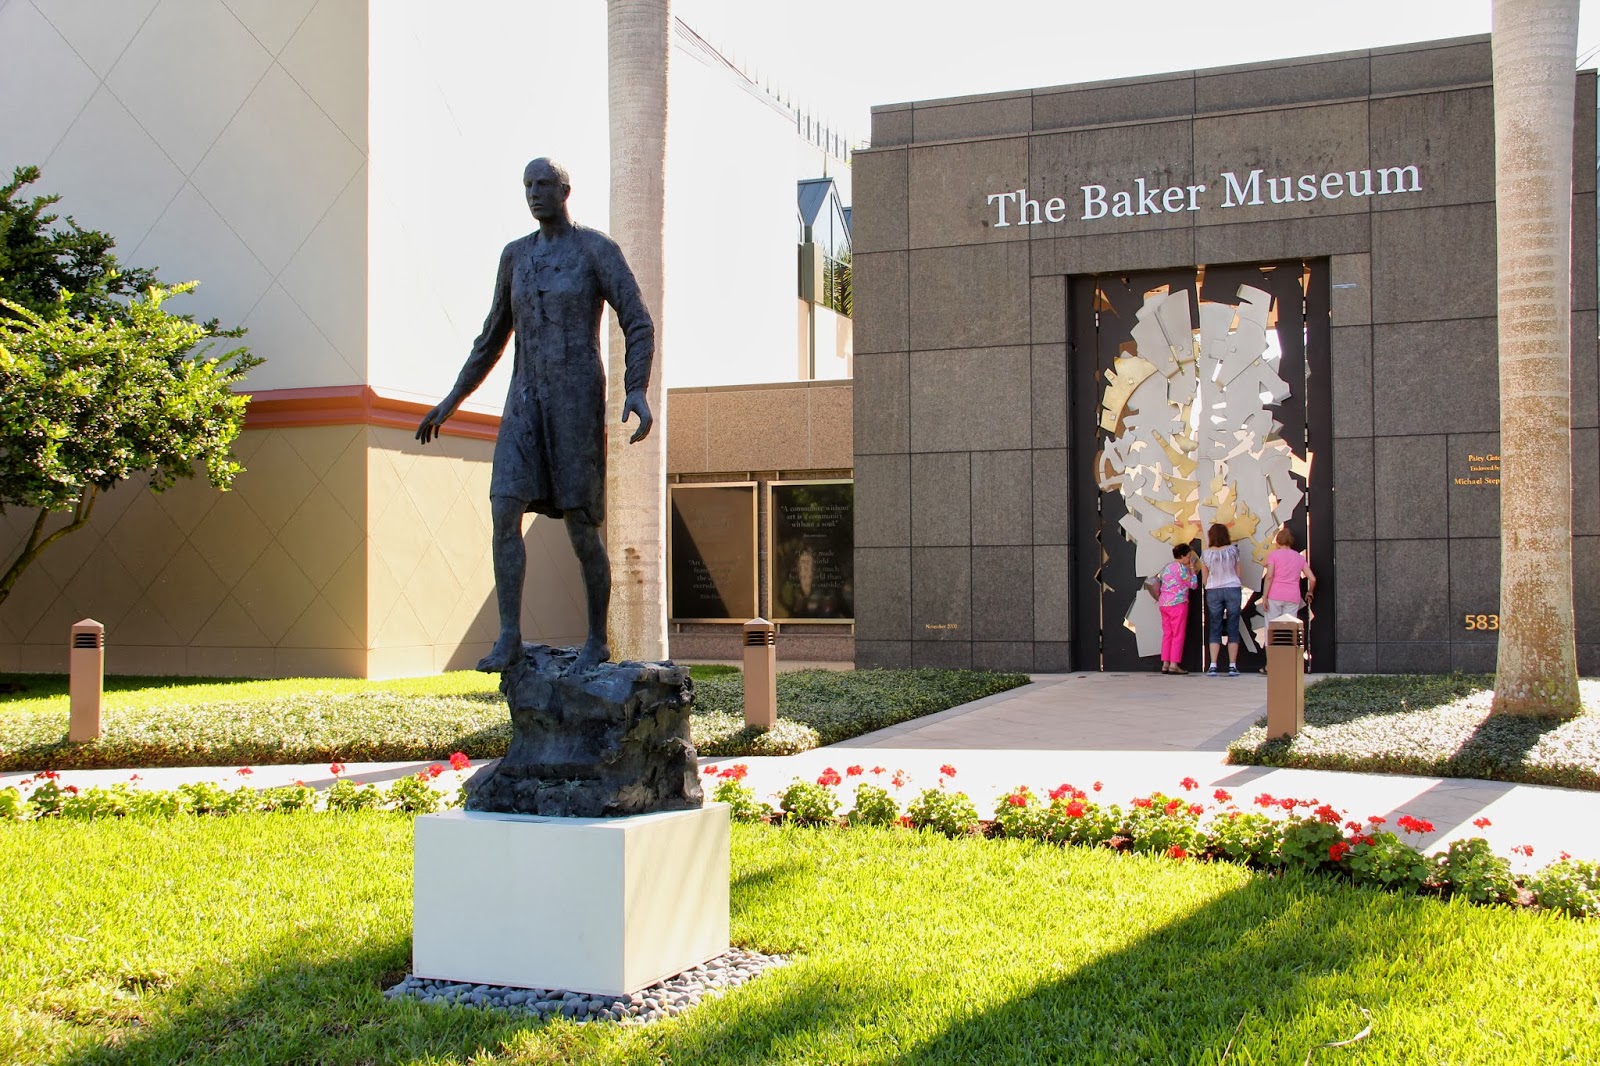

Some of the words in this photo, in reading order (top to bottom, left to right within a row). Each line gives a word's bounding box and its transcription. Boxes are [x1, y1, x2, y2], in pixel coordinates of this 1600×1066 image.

[987, 188, 1066, 228] The
[1080, 178, 1206, 221] Baker
[1220, 164, 1423, 208] Museum
[1468, 454, 1485, 463] Paley
[1455, 477, 1483, 485] Michael
[1484, 477, 1501, 486] Step
[825, 504, 850, 512] without
